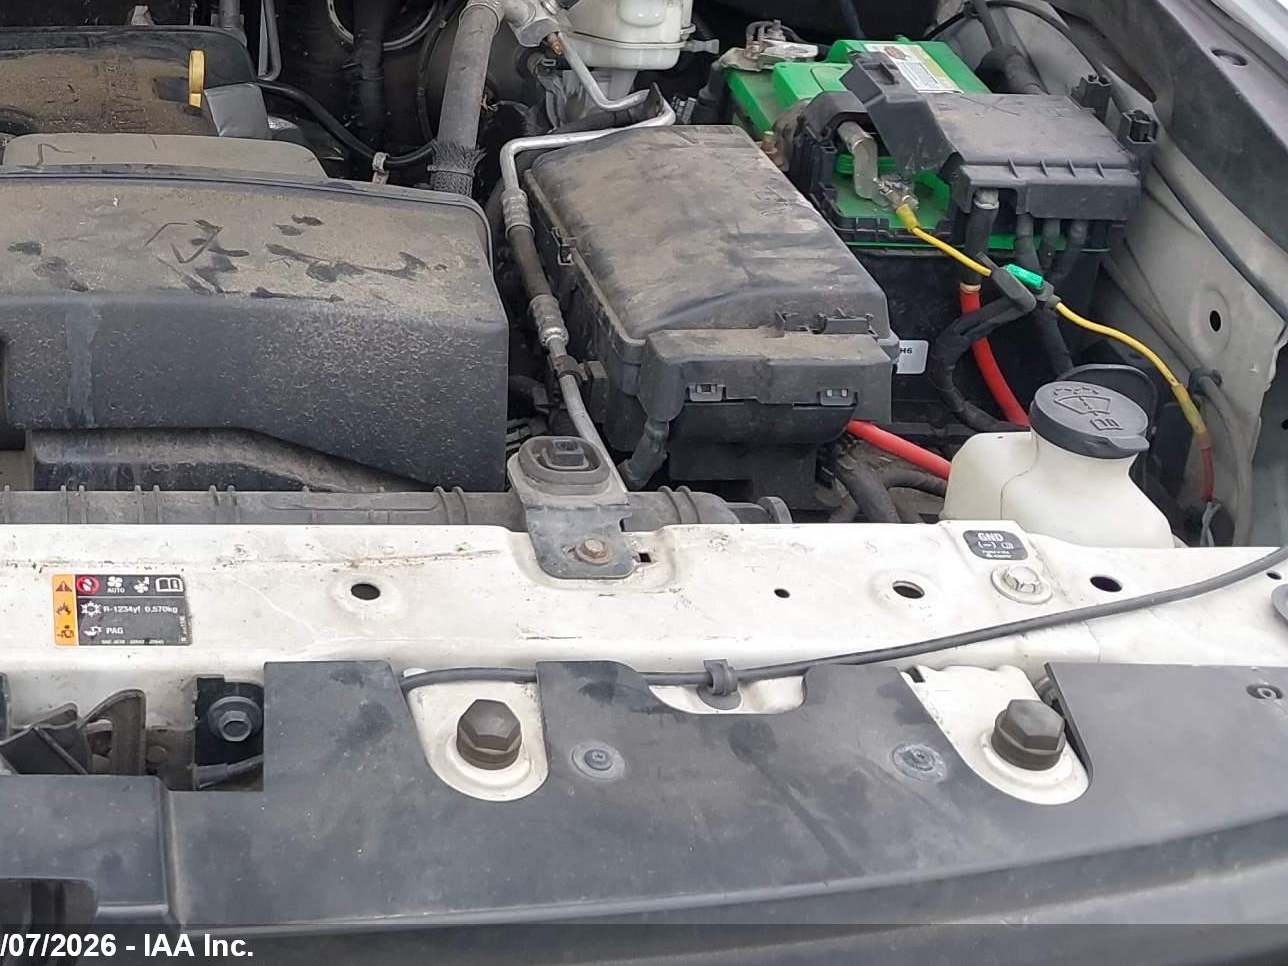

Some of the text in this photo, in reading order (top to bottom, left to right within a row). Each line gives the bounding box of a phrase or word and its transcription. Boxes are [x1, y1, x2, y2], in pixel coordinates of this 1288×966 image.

[977, 532, 1004, 542] GND
[103, 606, 178, 614] R-1234yf 0.570kg
